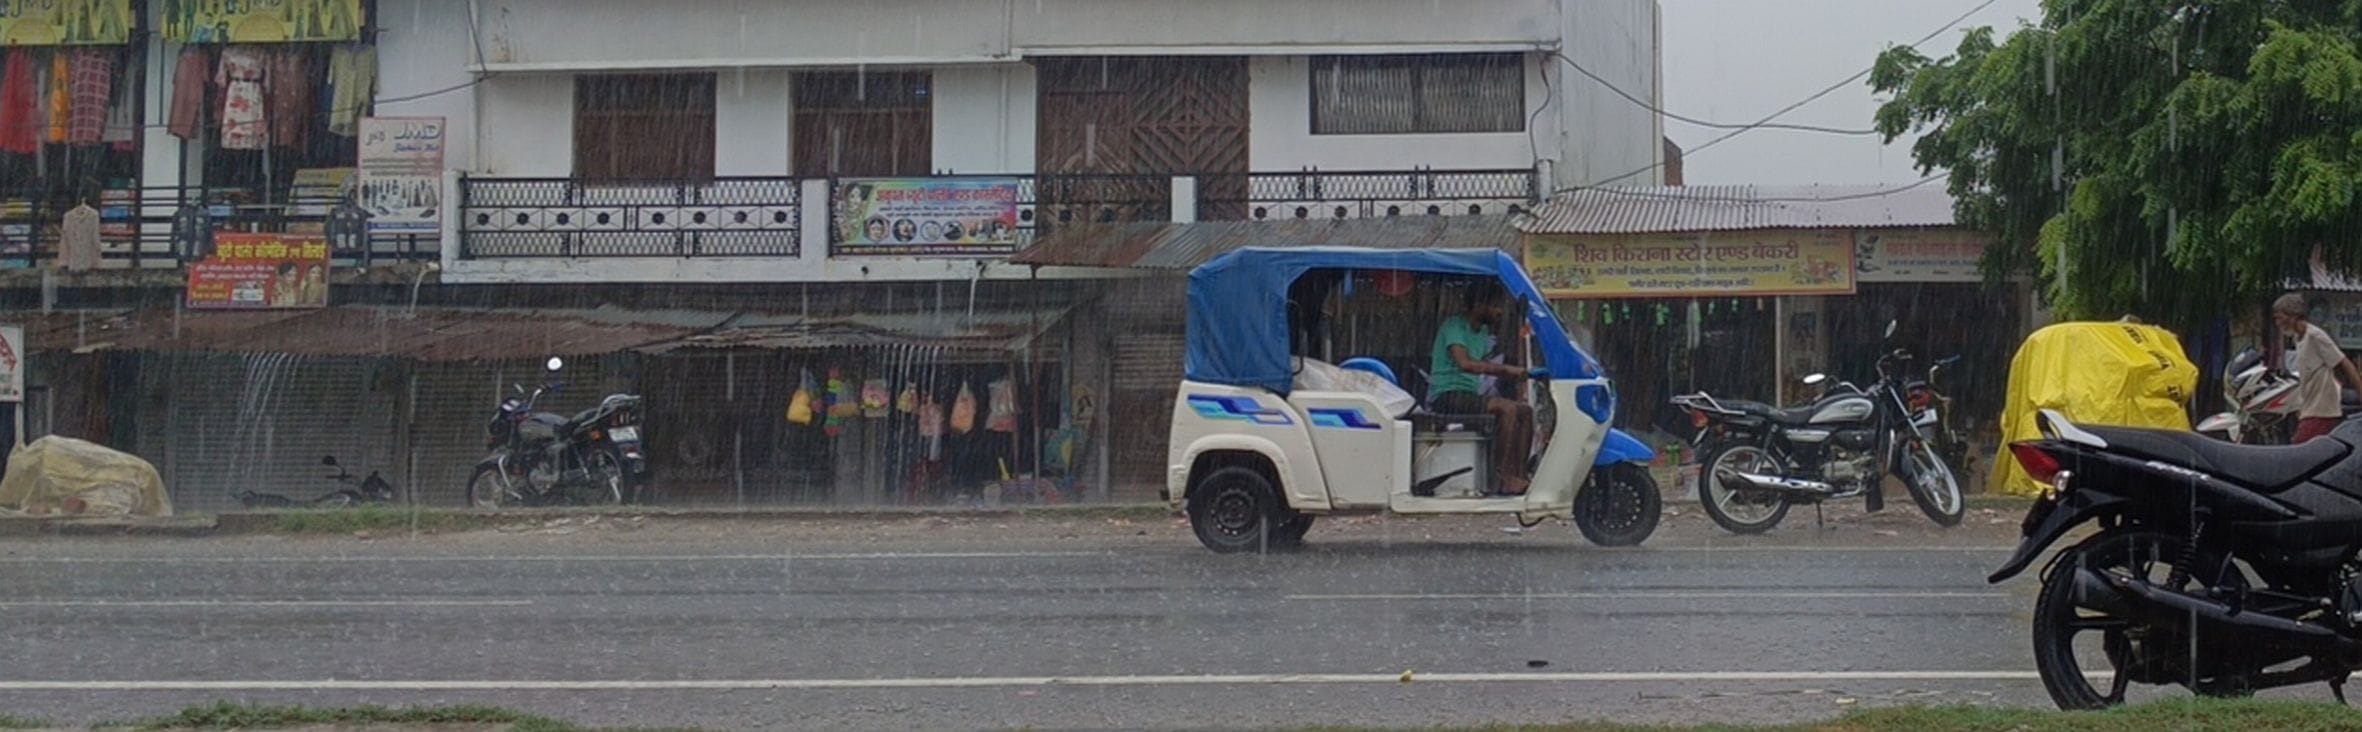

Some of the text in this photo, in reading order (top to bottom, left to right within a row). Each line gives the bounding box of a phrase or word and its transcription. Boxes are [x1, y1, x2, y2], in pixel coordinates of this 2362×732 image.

[394, 122, 440, 139] JMD
[1574, 243, 1607, 263] शिव
[1613, 243, 1671, 262] किराना
[1675, 241, 1712, 262] स्टोर
[1715, 245, 1749, 261] एण्ड
